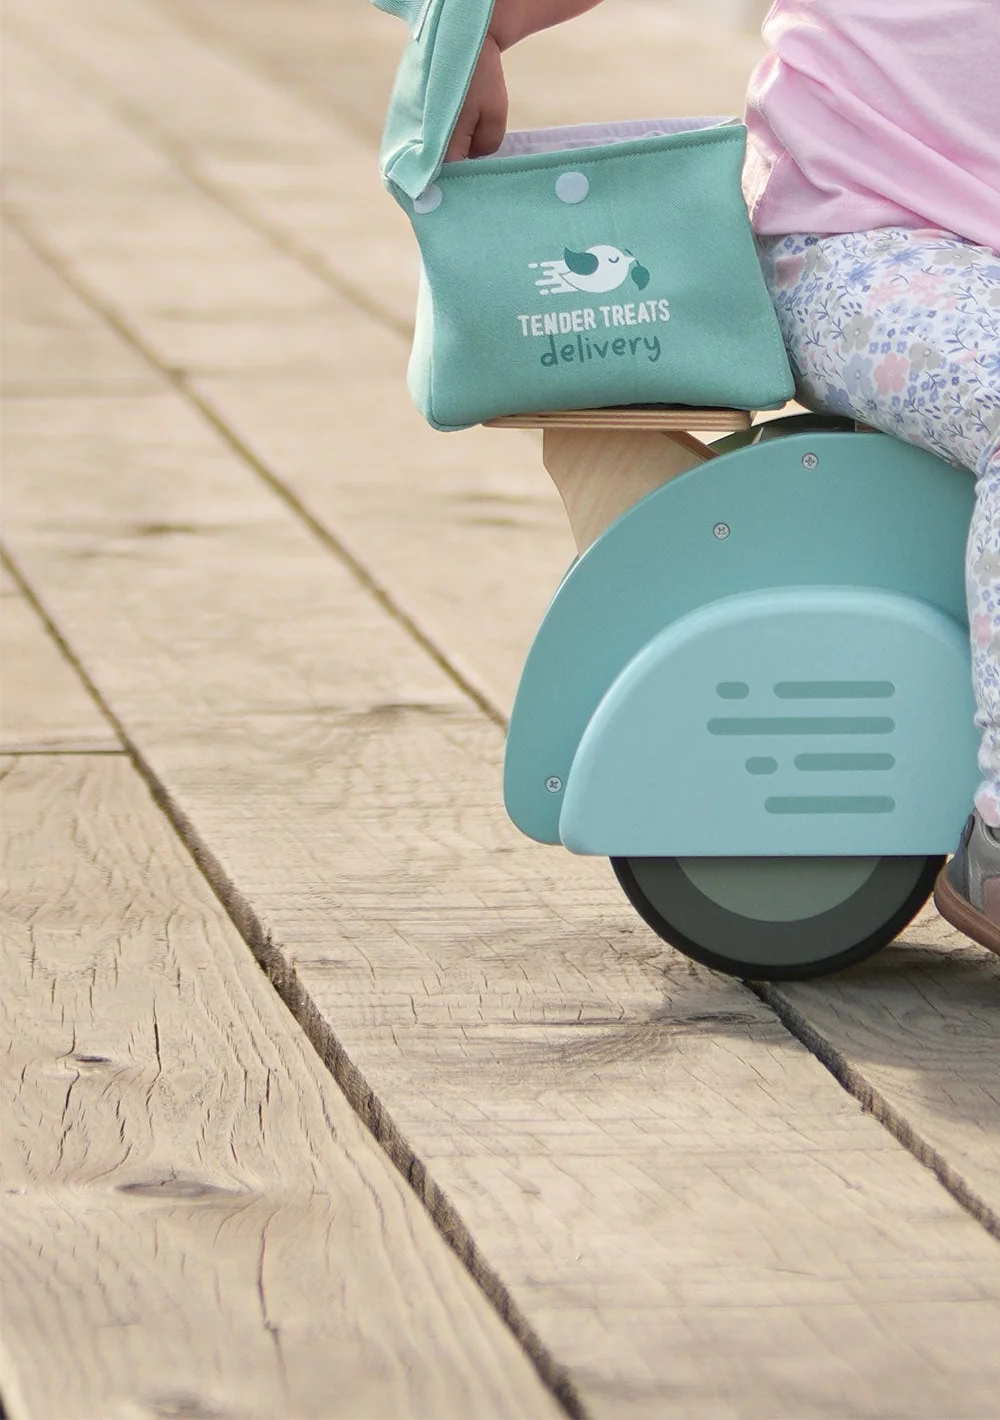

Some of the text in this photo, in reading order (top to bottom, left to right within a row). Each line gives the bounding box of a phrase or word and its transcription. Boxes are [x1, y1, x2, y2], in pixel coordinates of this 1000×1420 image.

[518, 298, 671, 336] TENDER TREATS
[540, 334, 661, 367] delivery
